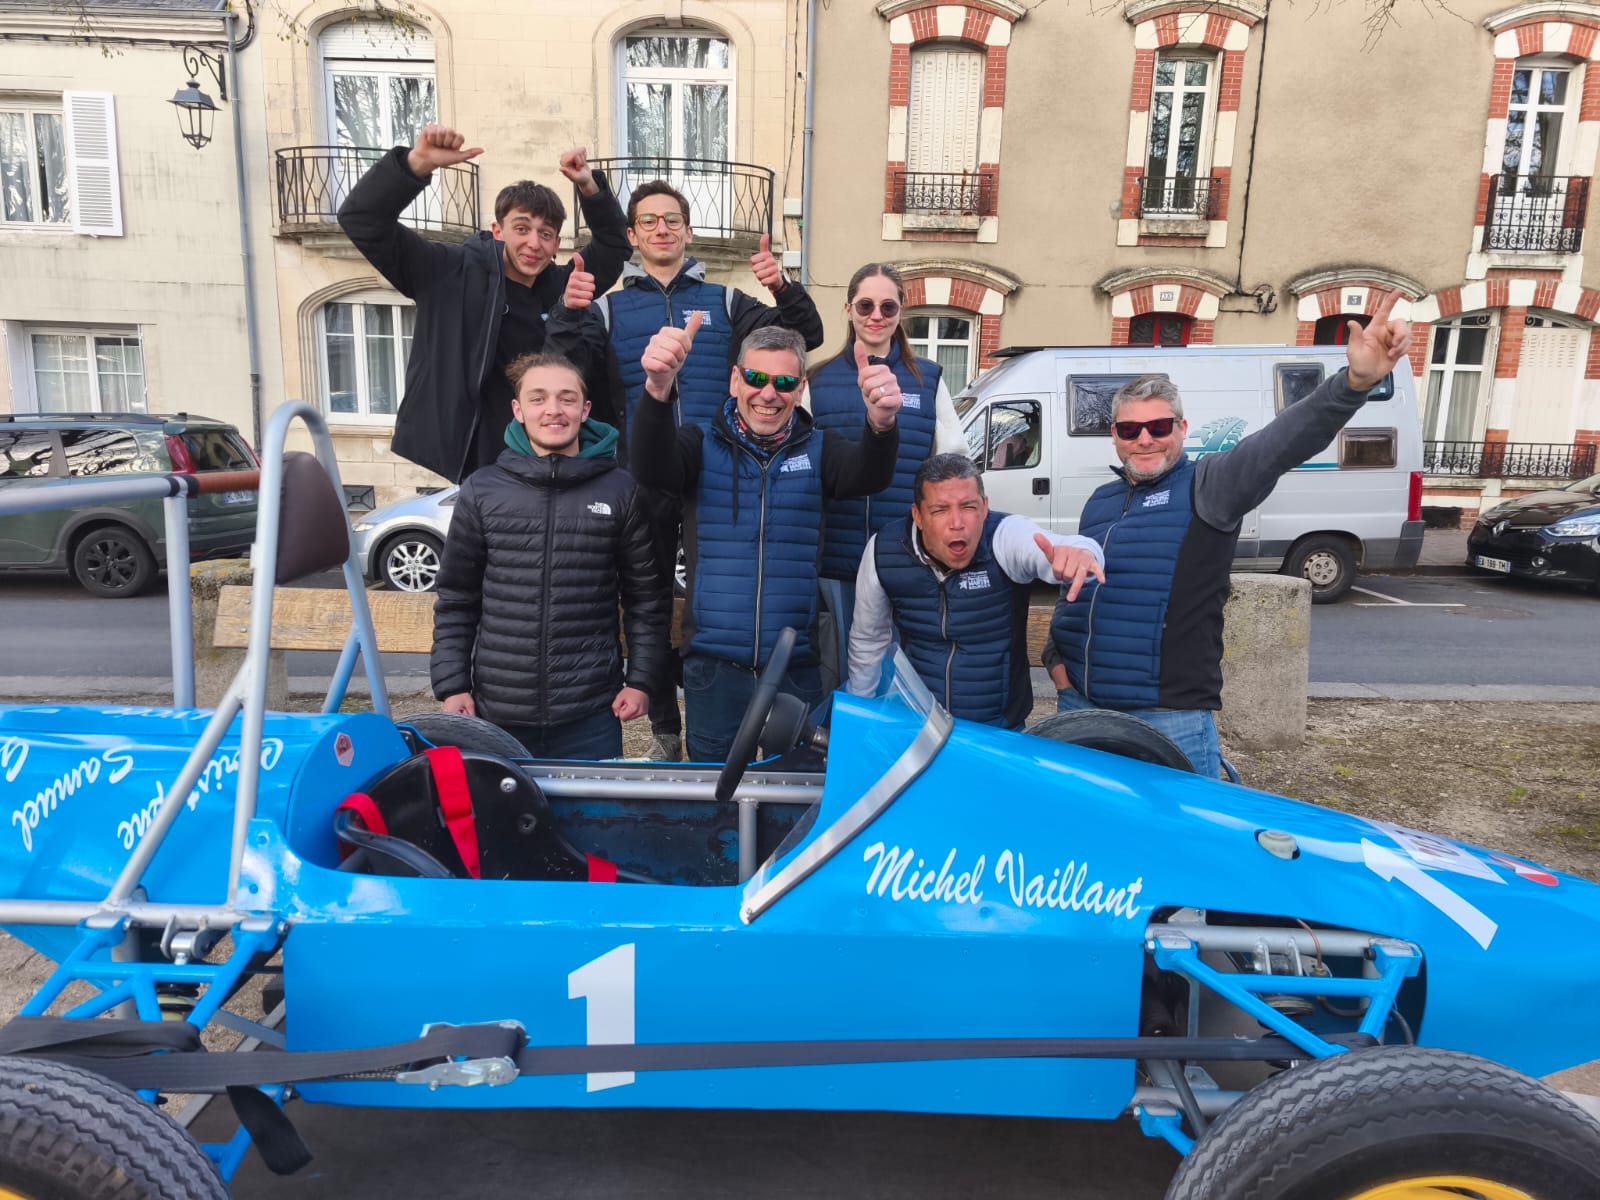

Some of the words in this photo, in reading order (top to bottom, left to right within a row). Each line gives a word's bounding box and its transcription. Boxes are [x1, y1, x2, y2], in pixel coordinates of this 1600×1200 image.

[12, 745, 134, 852] Samuel
[117, 738, 284, 850] Cristphe
[863, 841, 986, 904] Michel
[995, 849, 1142, 919] Vaillant
[1360, 837, 1499, 951] 1
[567, 942, 636, 1093] 1
